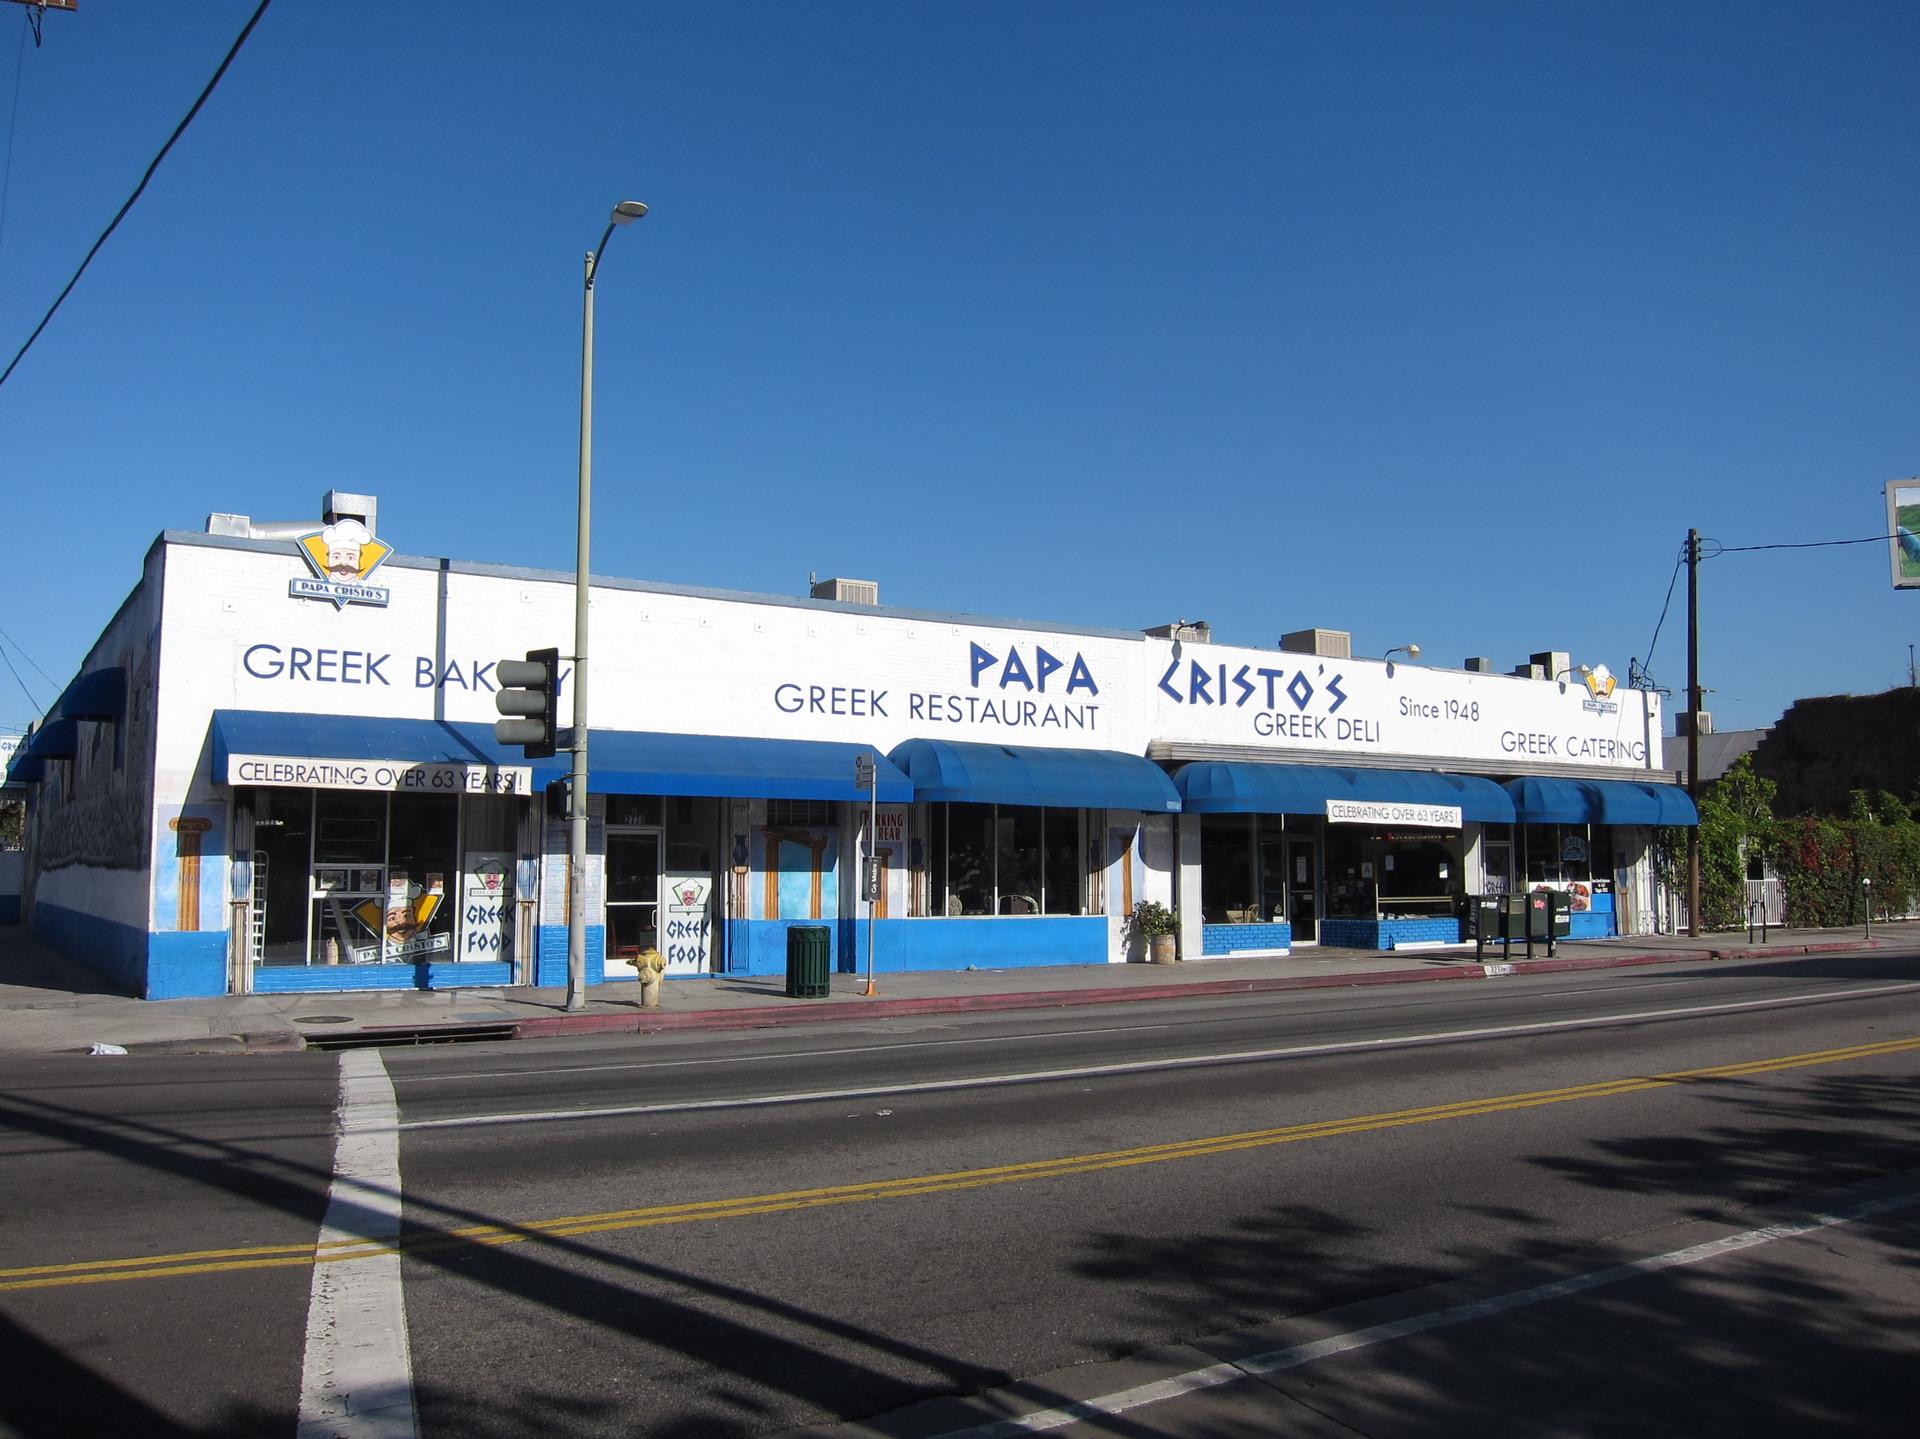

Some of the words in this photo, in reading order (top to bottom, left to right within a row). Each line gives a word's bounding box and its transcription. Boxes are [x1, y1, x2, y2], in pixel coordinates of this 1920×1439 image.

[301, 582, 330, 593] PAPA
[334, 586, 382, 599] CRISTO'S
[242, 642, 391, 686] GREEK
[415, 655, 573, 697] BAKY
[969, 640, 1100, 697] PAPA
[1158, 658, 1348, 714] CRISTO'S
[773, 682, 889, 718] GREEK
[909, 692, 1099, 731] RESTAURANT
[1399, 695, 1440, 719] Since
[1444, 699, 1480, 722] 1948
[1254, 711, 1327, 739] GREEK
[1337, 717, 1380, 743] DELI
[1500, 730, 1558, 755] GREEK
[1566, 736, 1646, 761] CATERING
[238, 761, 368, 786] CELEBRATING
[377, 767, 427, 789] OVER
[432, 771, 454, 789] 63
[864, 813, 903, 827] PRKING
[1331, 805, 1390, 820] CELEBRATING
[1391, 807, 1415, 820] OVER
[1417, 810, 1428, 821] 63
[878, 827, 901, 841] REAR
[871, 884, 878, 894] Go
[1486, 880, 1507, 895] GREEK
[466, 904, 515, 925] GREEK
[666, 919, 711, 939] GREEK
[468, 931, 512, 953] FOOD
[668, 943, 707, 965] FOOD
